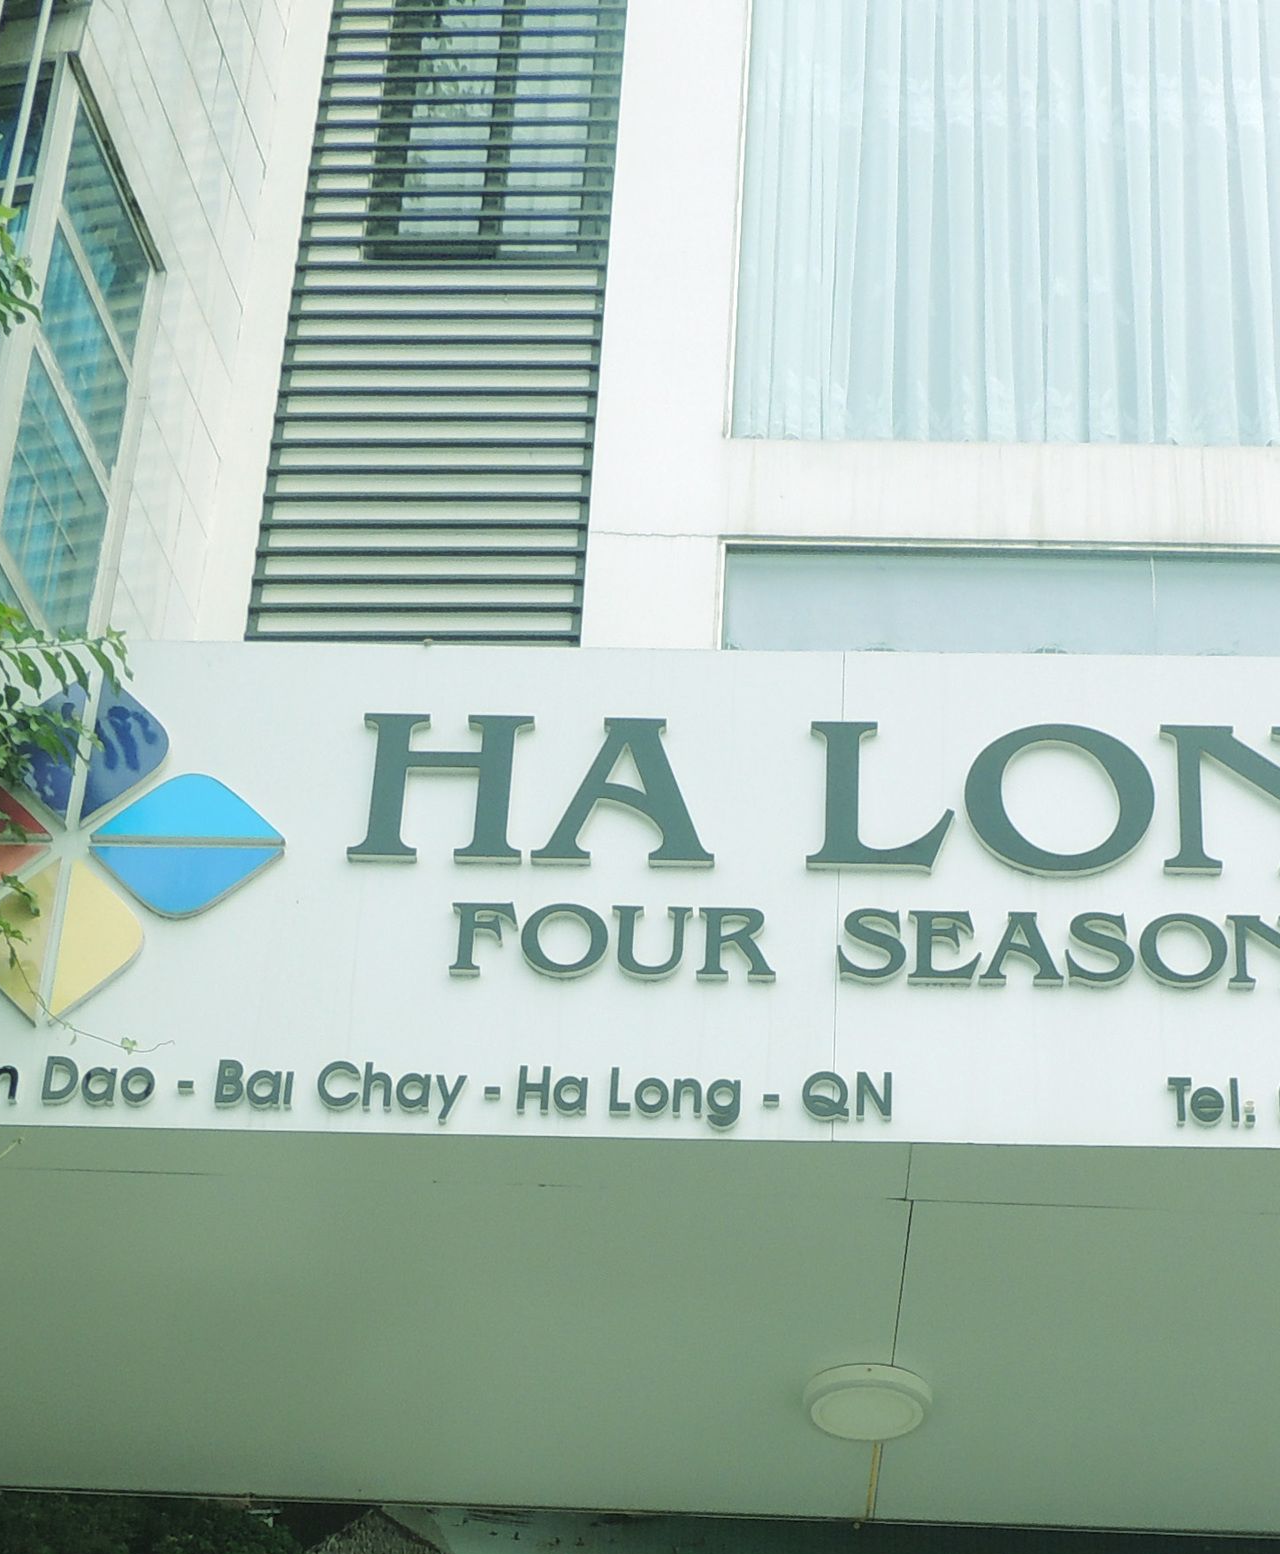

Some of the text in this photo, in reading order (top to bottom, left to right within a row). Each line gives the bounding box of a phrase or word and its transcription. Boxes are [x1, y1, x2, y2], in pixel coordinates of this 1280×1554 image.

[347, 713, 714, 869] HA
[448, 901, 776, 981] FOUR
[41, 1056, 155, 1107] Dao
[317, 1061, 467, 1124] Chay
[516, 1065, 588, 1115] Ha
[609, 1067, 741, 1131] Long
[802, 1071, 892, 1121] QN
